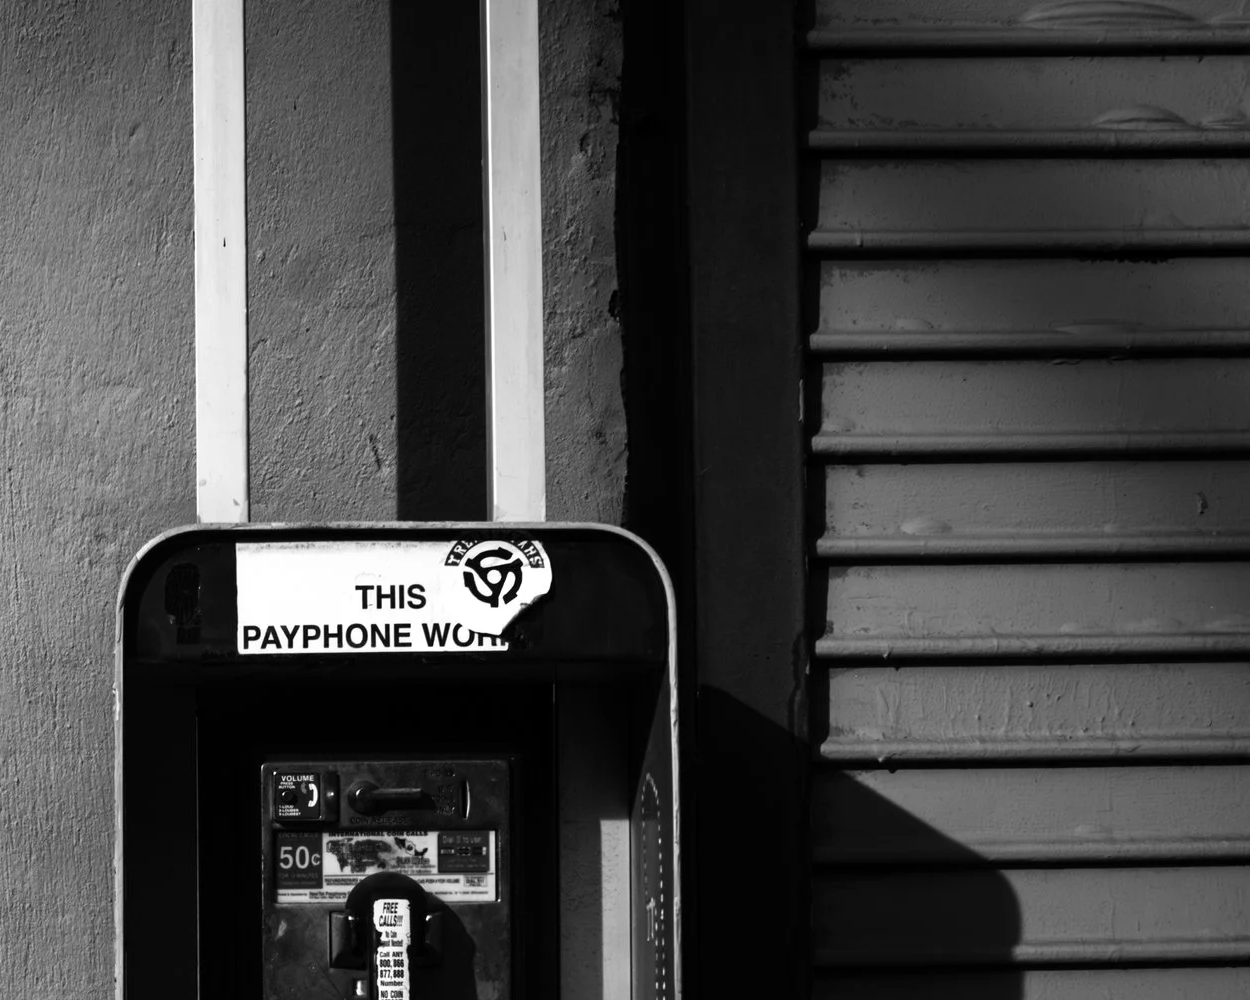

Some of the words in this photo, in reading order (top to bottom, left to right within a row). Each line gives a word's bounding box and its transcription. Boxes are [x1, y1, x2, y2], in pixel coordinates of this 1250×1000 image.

[355, 584, 427, 610] THIS
[242, 623, 412, 650] PAYPHONE
[281, 774, 315, 782] VOLUME
[383, 902, 399, 914] FREE
[380, 959, 392, 969] 800,
[380, 969, 392, 979] 877,
[393, 969, 404, 978] 888
[381, 990, 388, 998] NO
[390, 990, 403, 998] COIN
